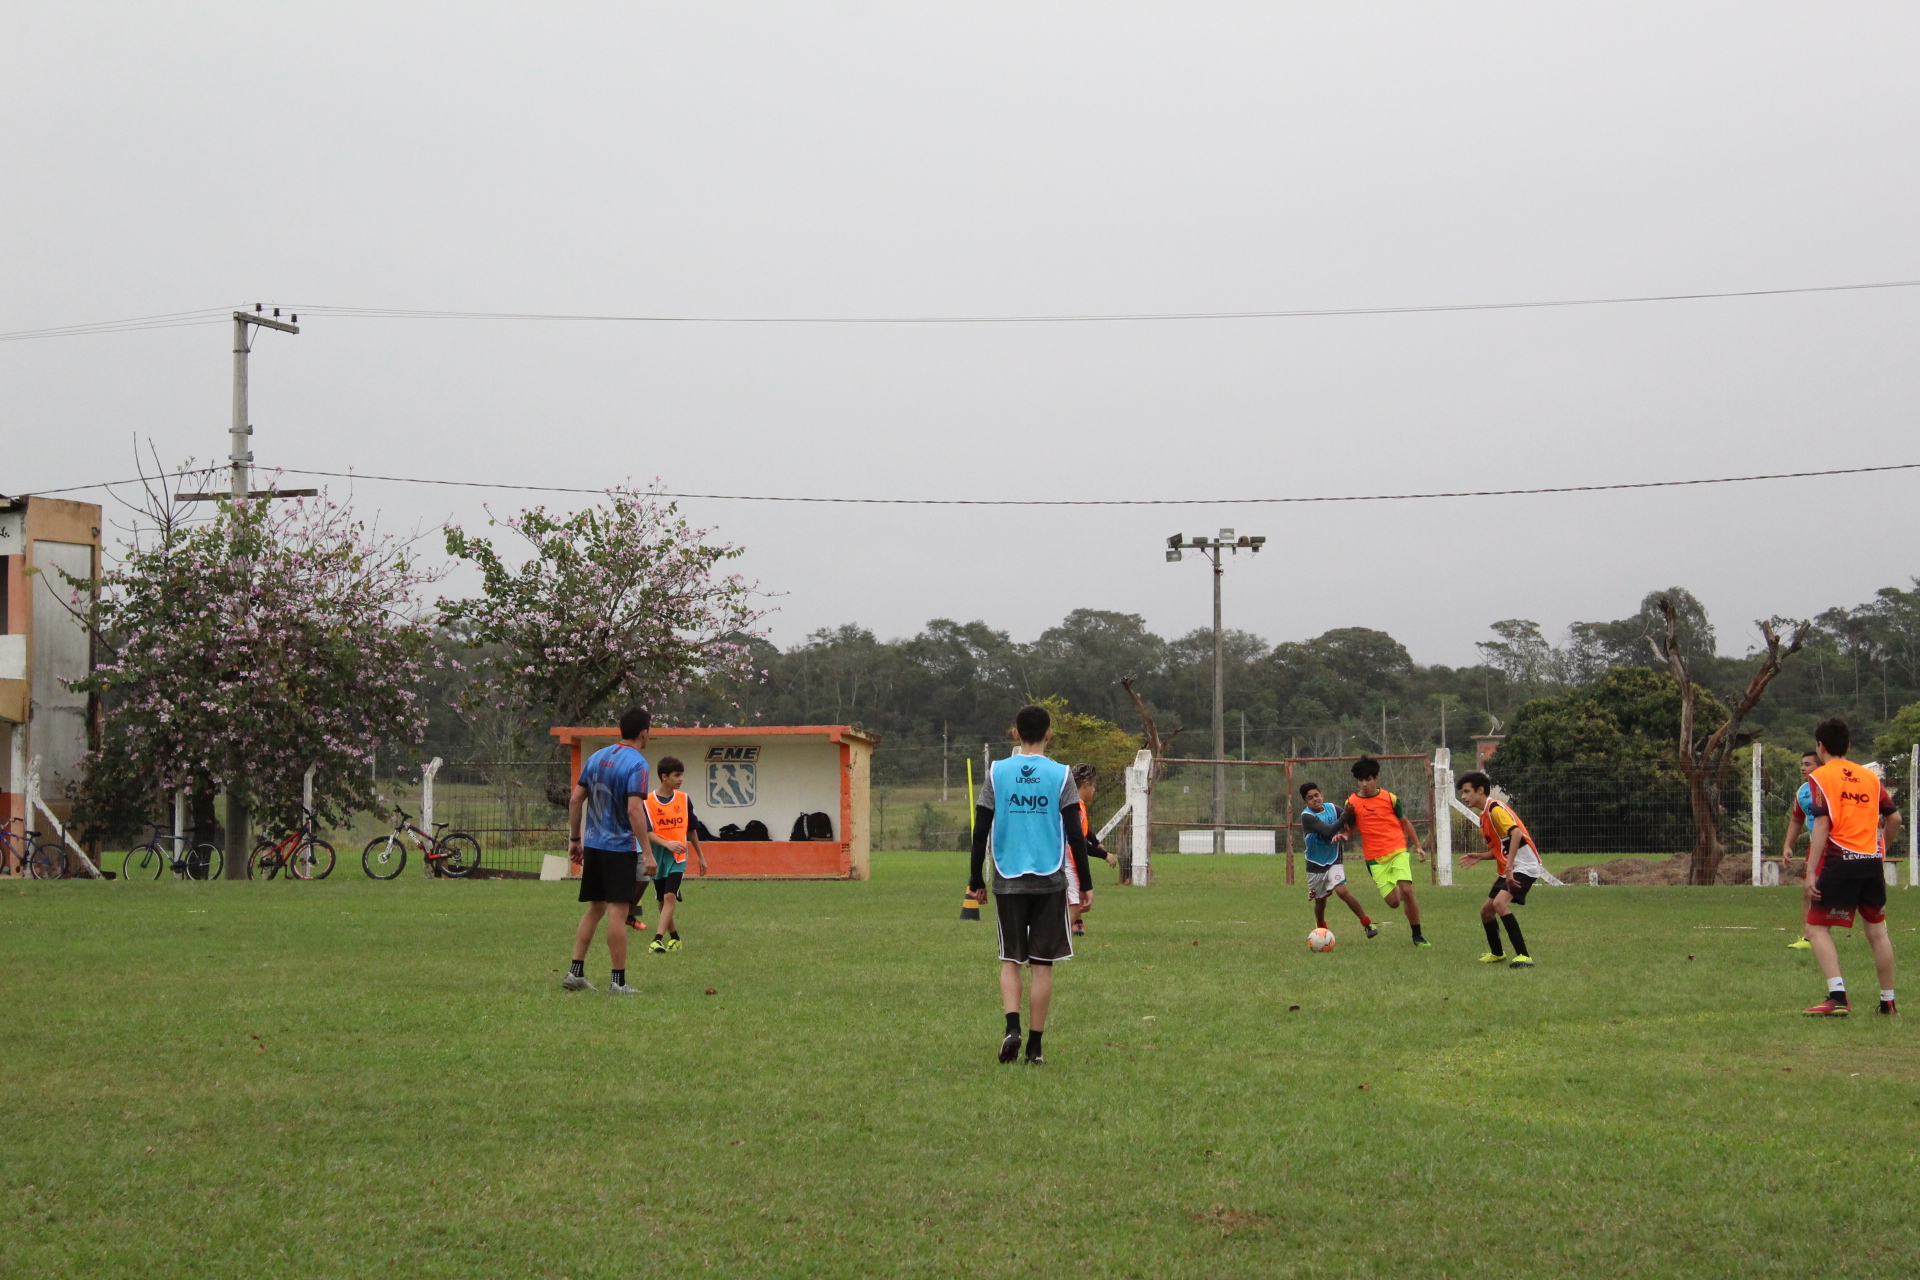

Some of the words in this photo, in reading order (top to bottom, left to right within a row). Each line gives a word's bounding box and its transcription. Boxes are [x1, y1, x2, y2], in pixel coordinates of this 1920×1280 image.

[708, 747, 758, 760] FME
[1015, 776, 1041, 784] unesc
[1009, 793, 1049, 811] ANJO
[1840, 791, 1870, 805] ANJO
[658, 817, 684, 826] ANJO
